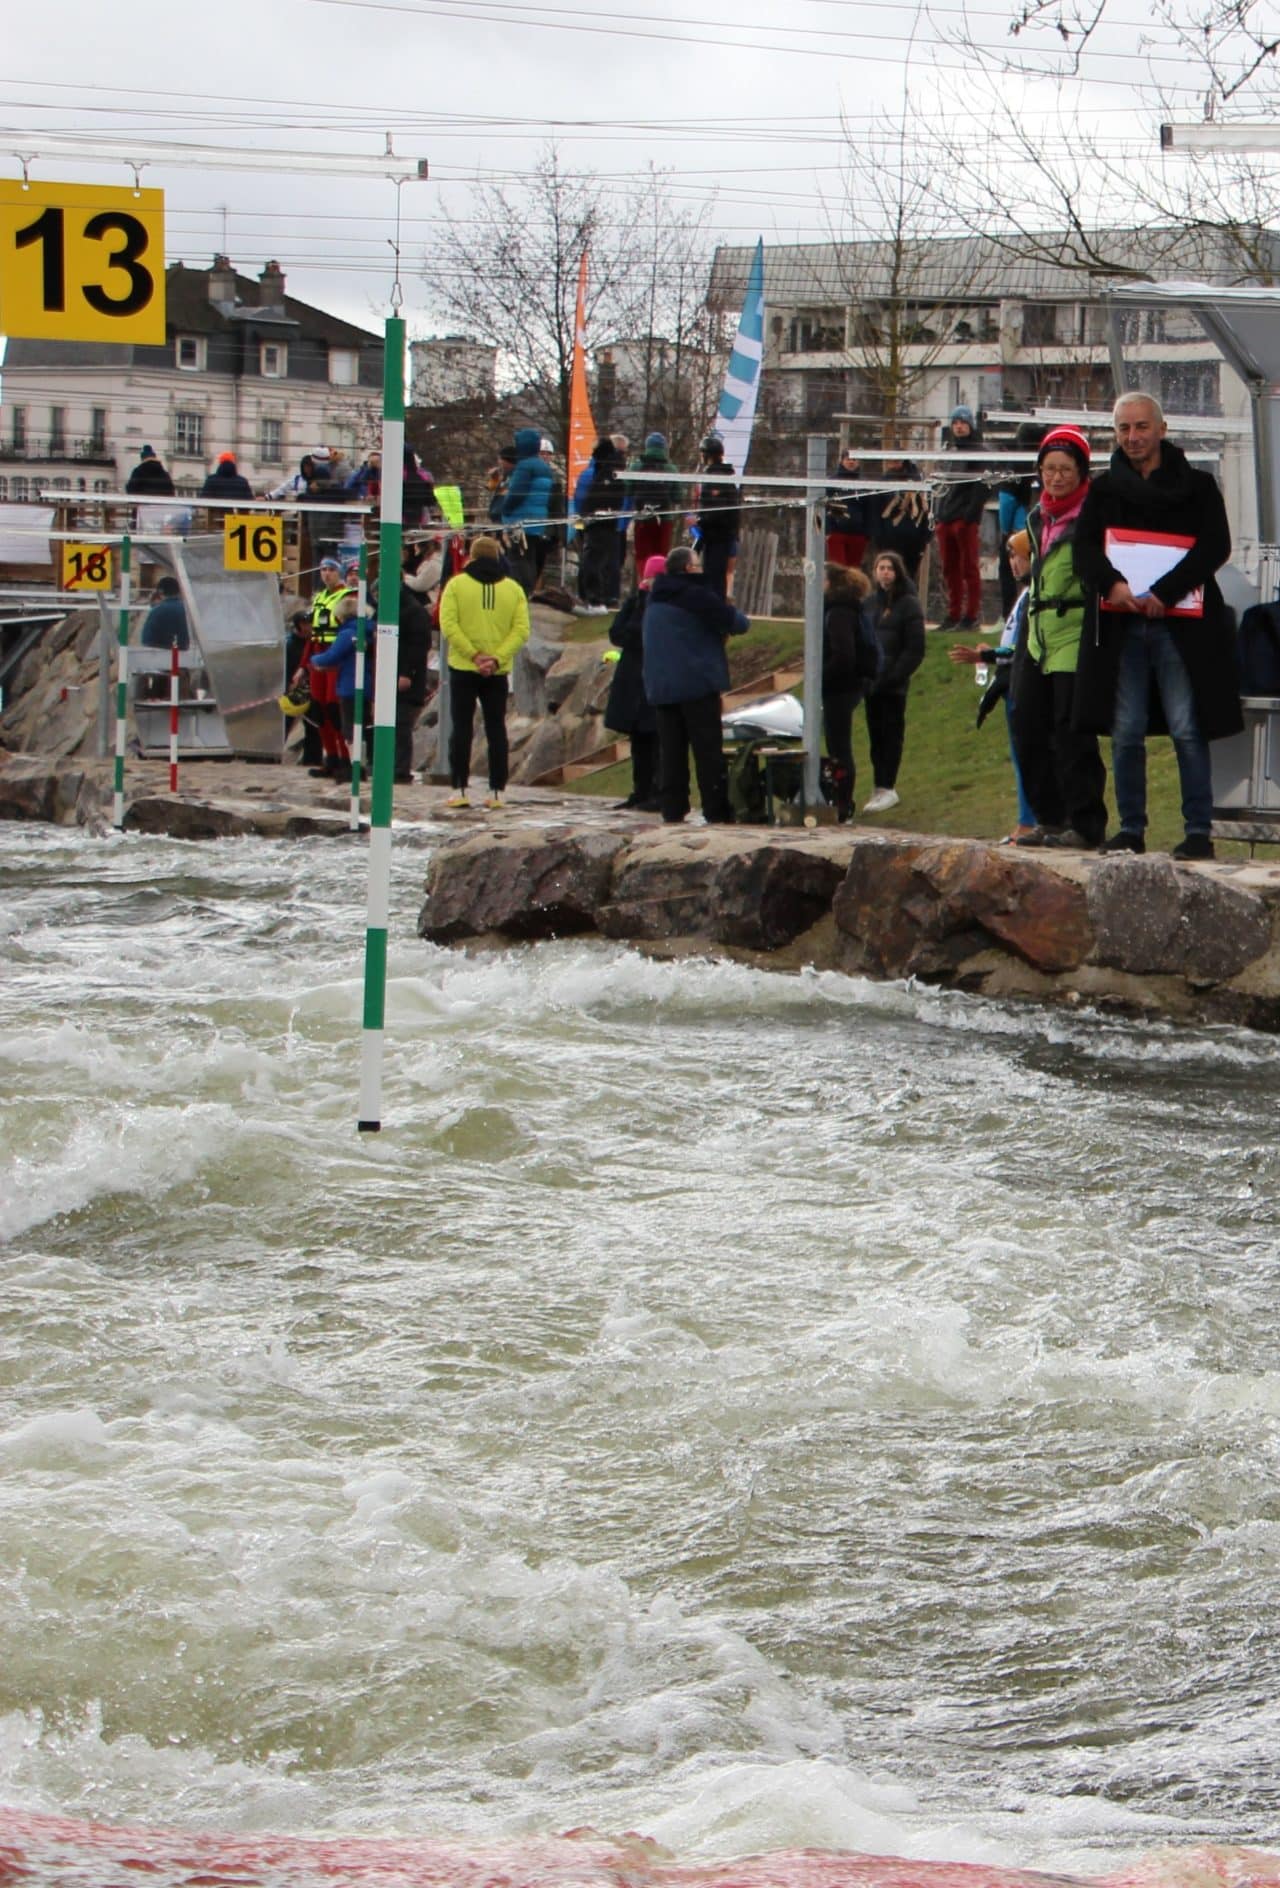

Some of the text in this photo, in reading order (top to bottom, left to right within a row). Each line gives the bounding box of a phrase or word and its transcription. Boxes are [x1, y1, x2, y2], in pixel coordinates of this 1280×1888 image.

[15, 207, 154, 317] 13
[229, 525, 278, 562] 16
[68, 552, 107, 583] 18
